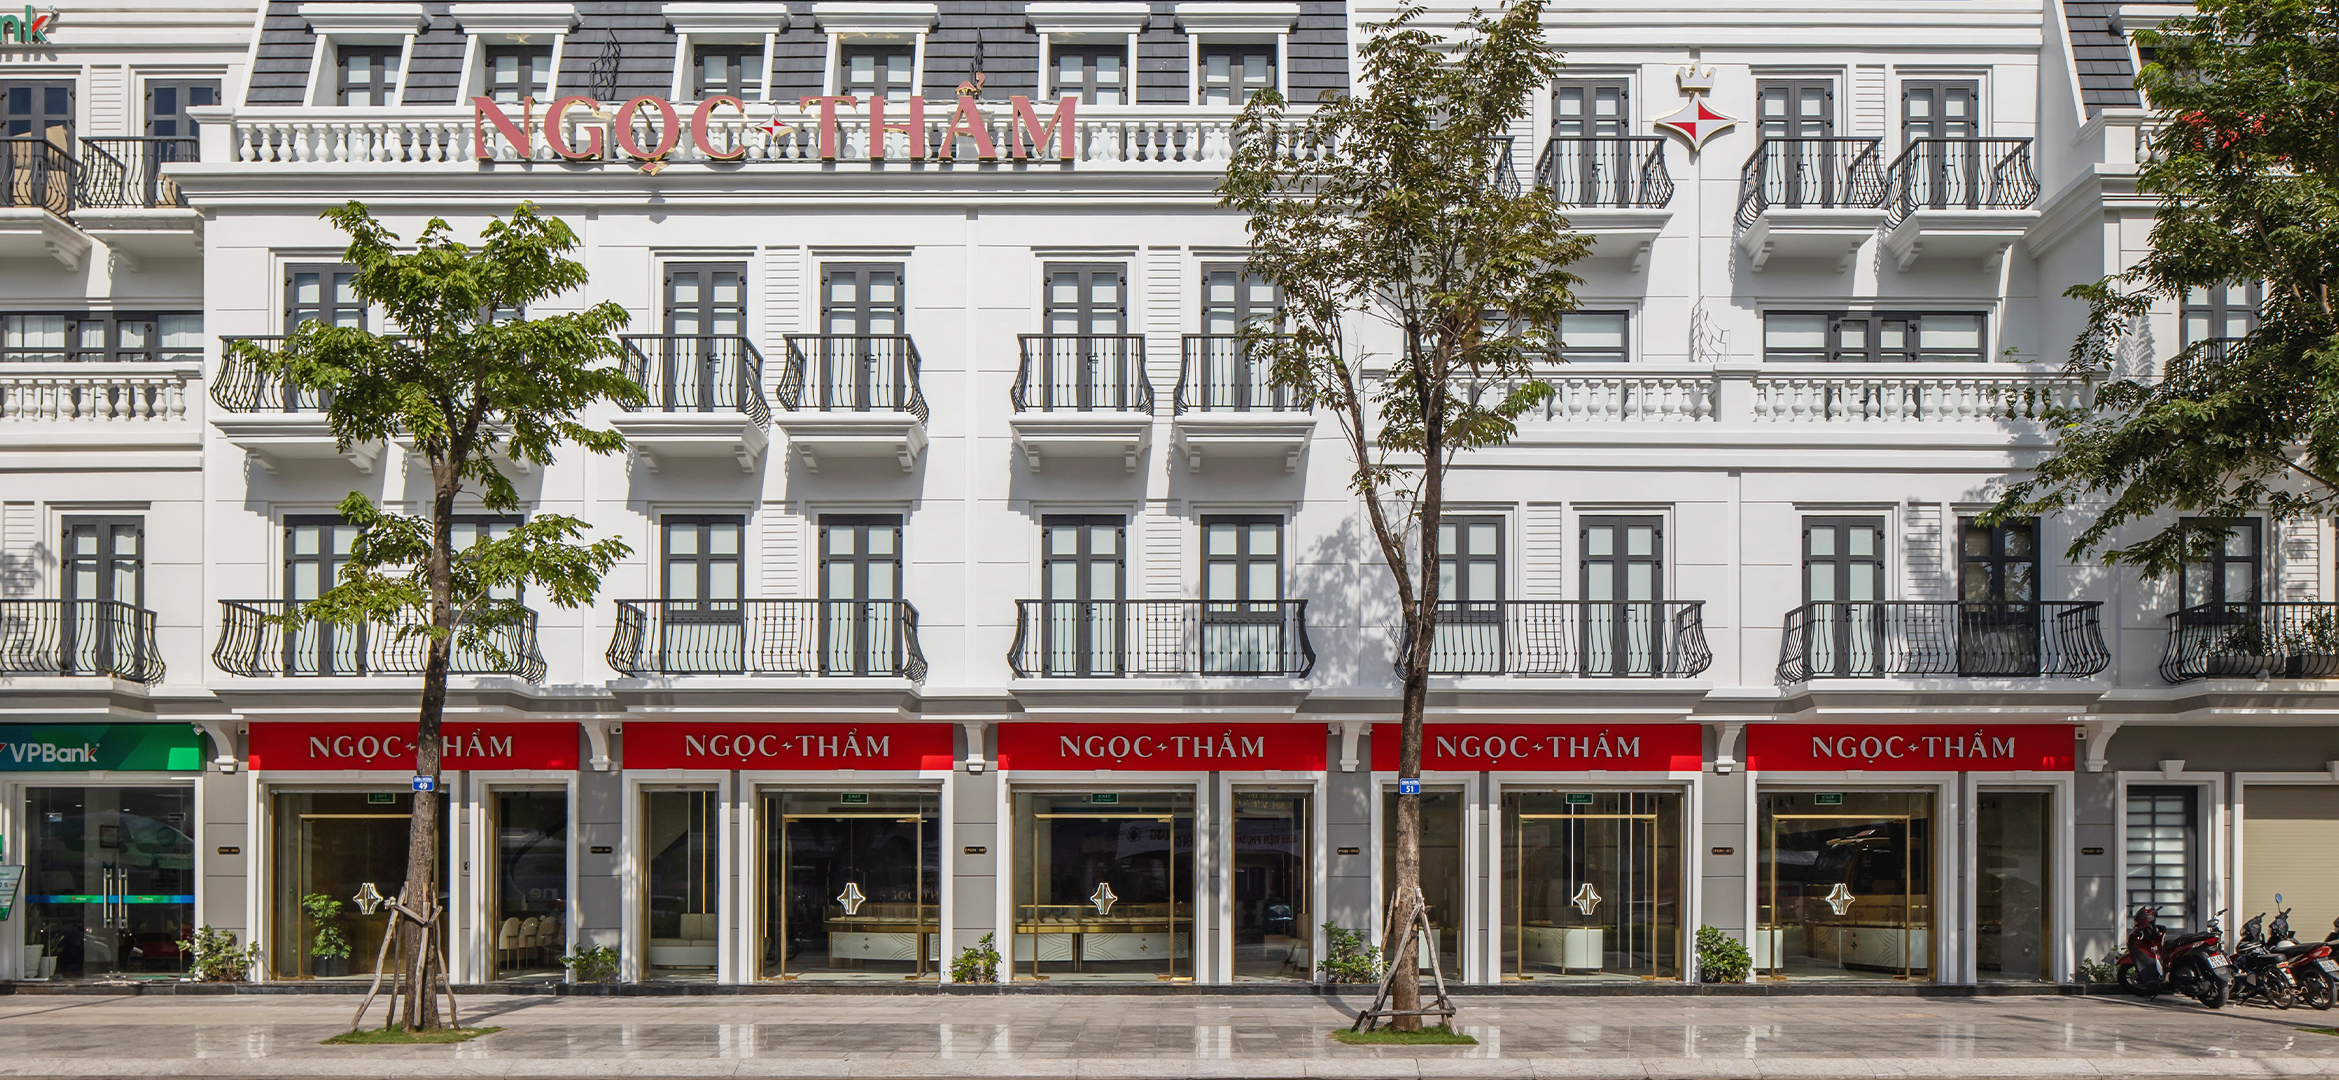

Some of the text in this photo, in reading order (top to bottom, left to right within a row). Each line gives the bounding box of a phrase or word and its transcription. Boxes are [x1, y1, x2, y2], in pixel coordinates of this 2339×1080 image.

[470, 72, 1078, 175] NGỌC THẨM
[10, 743, 98, 763] VPBank
[309, 728, 512, 763] NGỌC HẨM
[685, 728, 889, 762] NGỌC THẨM
[1060, 729, 1264, 763] NGỌC THẨM
[1436, 729, 1640, 764] NGỌC THẨM
[1812, 729, 2015, 764] NGỌC THẨM
[1405, 785, 1414, 793] 51
